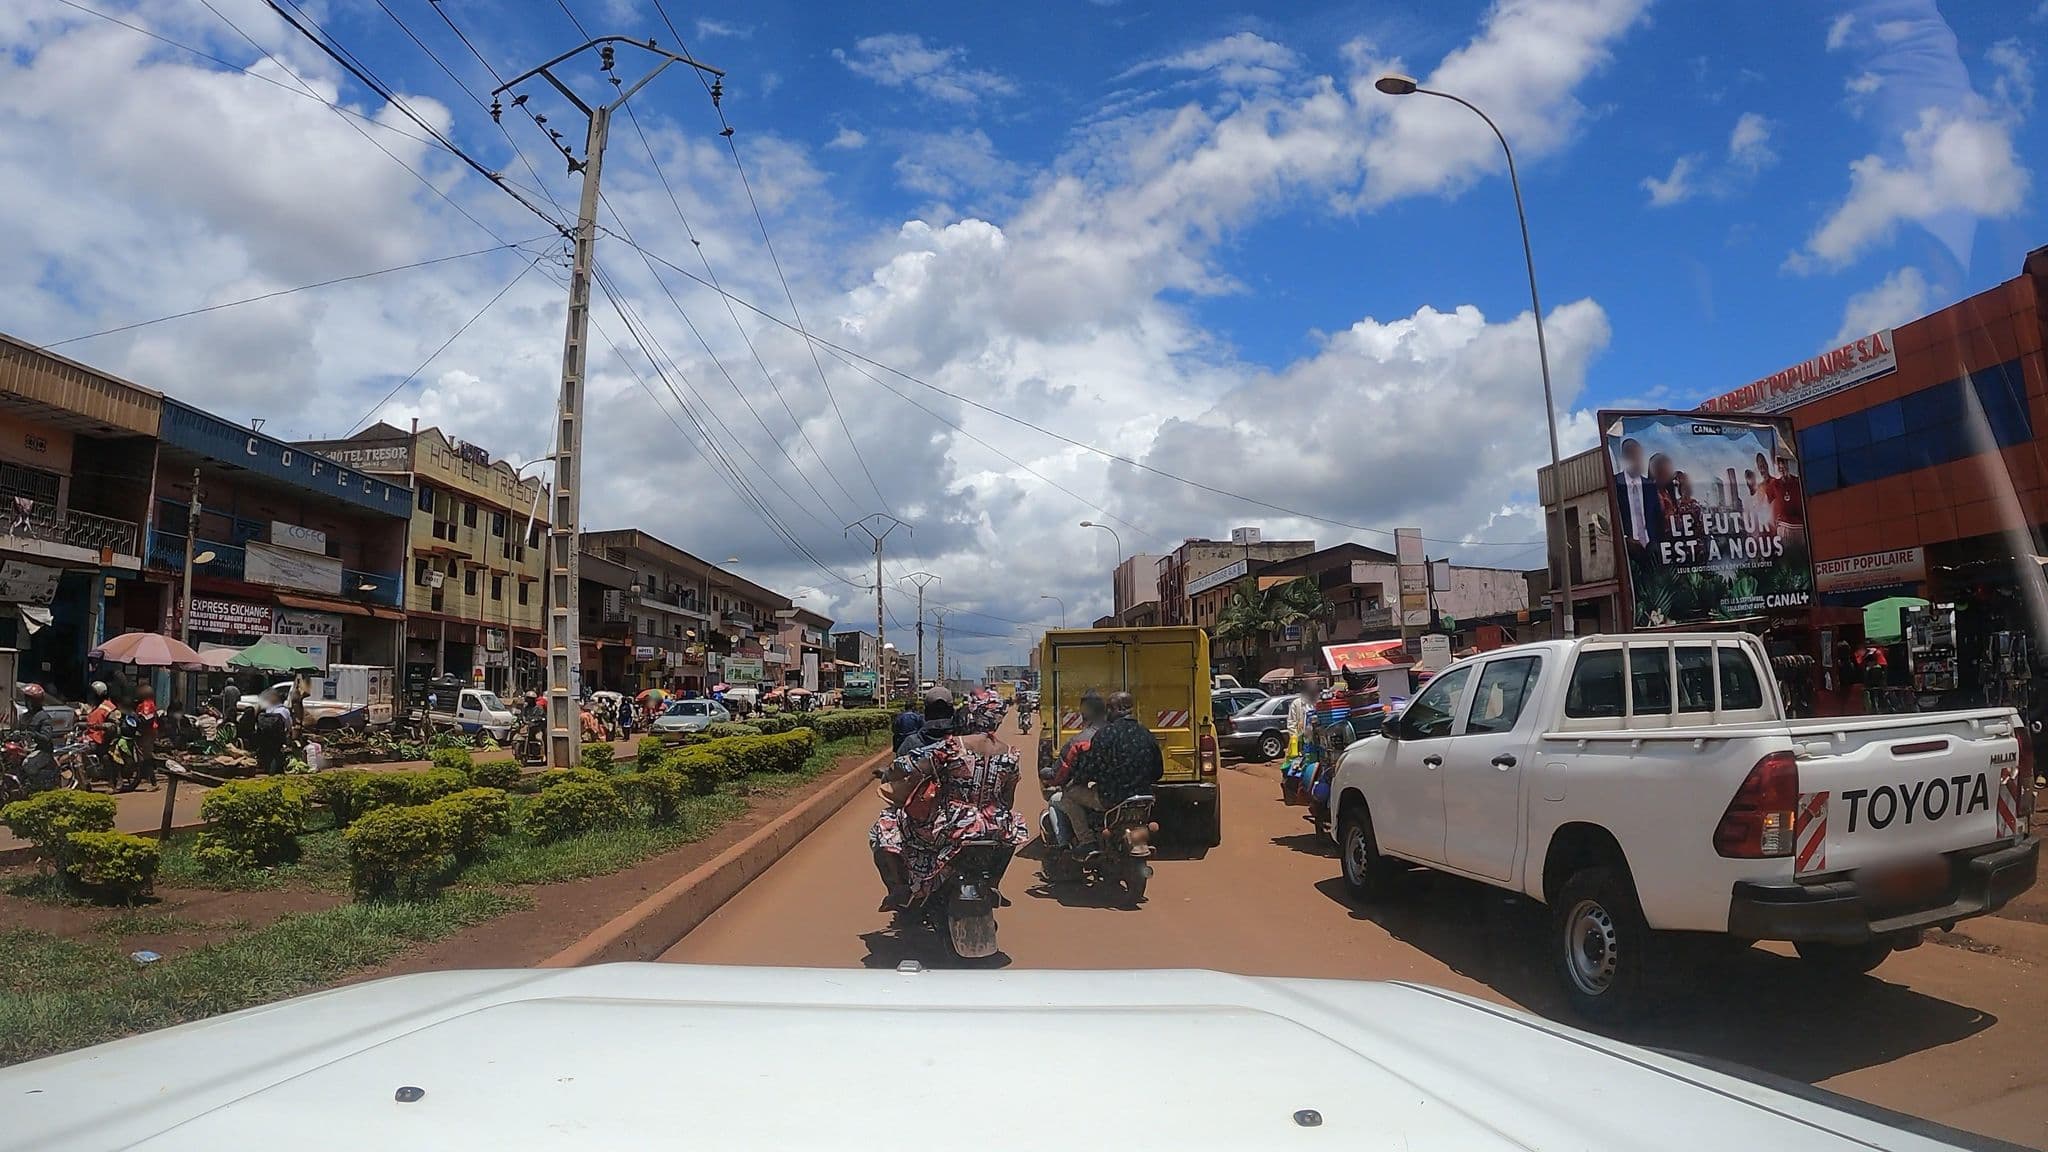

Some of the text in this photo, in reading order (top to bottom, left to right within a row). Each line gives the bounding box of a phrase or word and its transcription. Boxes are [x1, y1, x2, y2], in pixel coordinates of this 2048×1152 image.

[1768, 344, 1857, 397] POPULAIRE
[1693, 424, 1721, 434] CANAL+
[329, 446, 408, 463] HOTEL TRESOR
[429, 443, 480, 483] HOTEL
[1669, 511, 1770, 537] LE FUTUR
[1660, 534, 1784, 565] EST À NOUS
[1815, 559, 1852, 575] CREDIT
[1853, 550, 1914, 570] POPULAIRE
[191, 599, 270, 618] EXPRESS EXCHANGE
[1766, 591, 1809, 608] CANAL+
[1989, 751, 2017, 765] HILUX
[1841, 772, 1990, 833] TOYOTA
